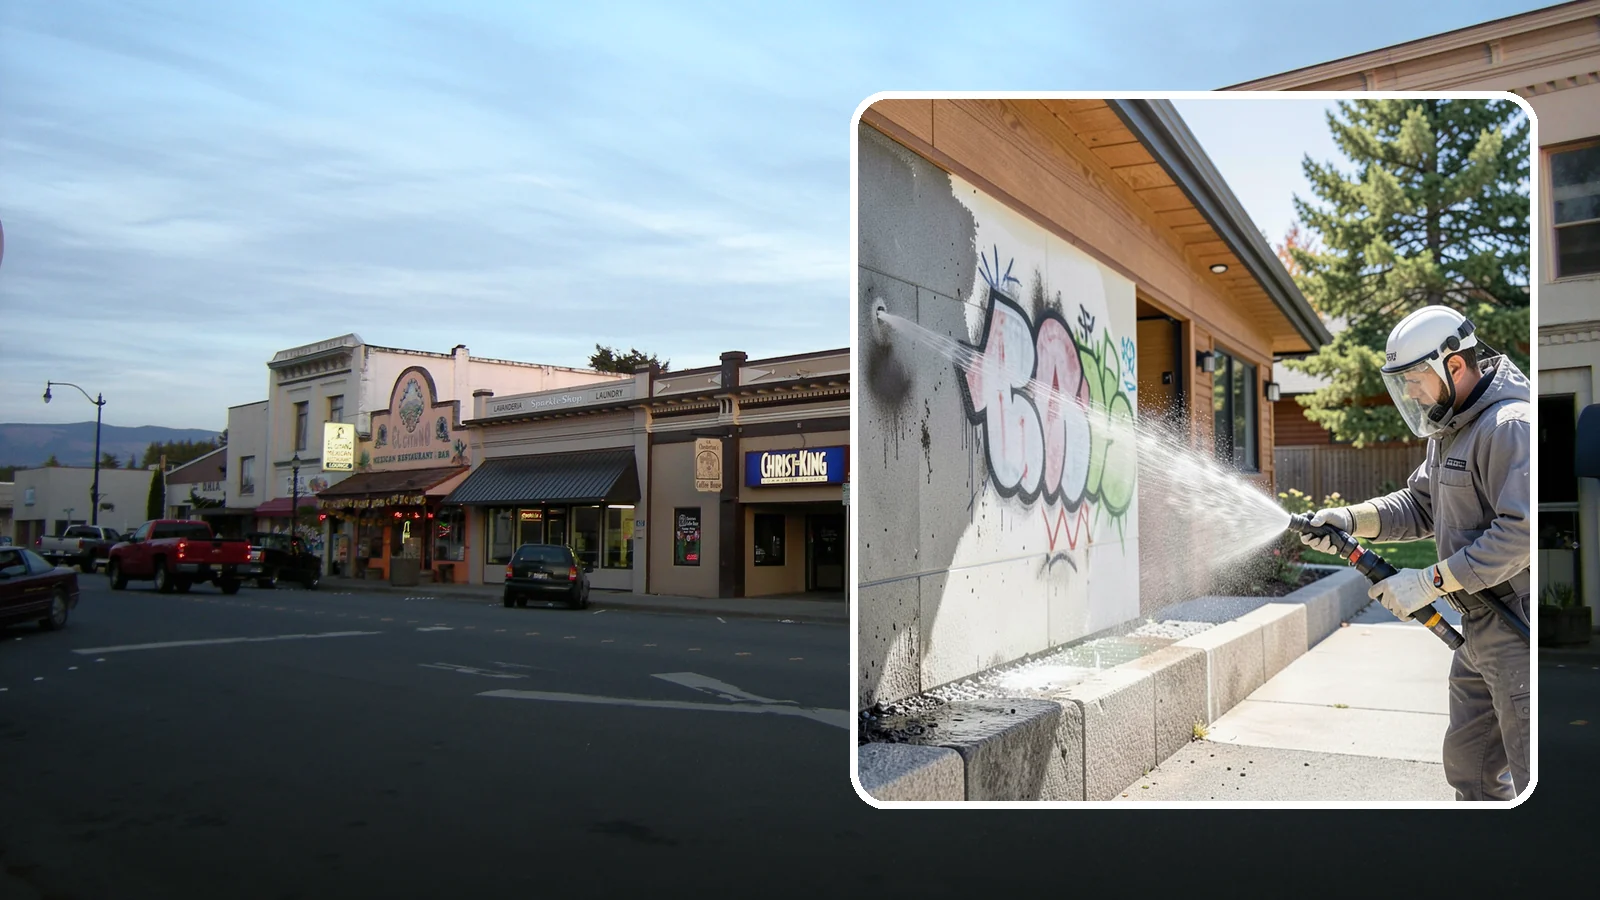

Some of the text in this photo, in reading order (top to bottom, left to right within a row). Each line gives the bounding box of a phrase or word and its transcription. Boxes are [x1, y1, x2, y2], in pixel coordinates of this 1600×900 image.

[494, 389, 623, 412] LAVANDERIA Sparkle Shop LAUNDRY
[373, 450, 450, 464] MEXICAN RESTAURANT BAR
[761, 450, 827, 477] CHRIST KING
